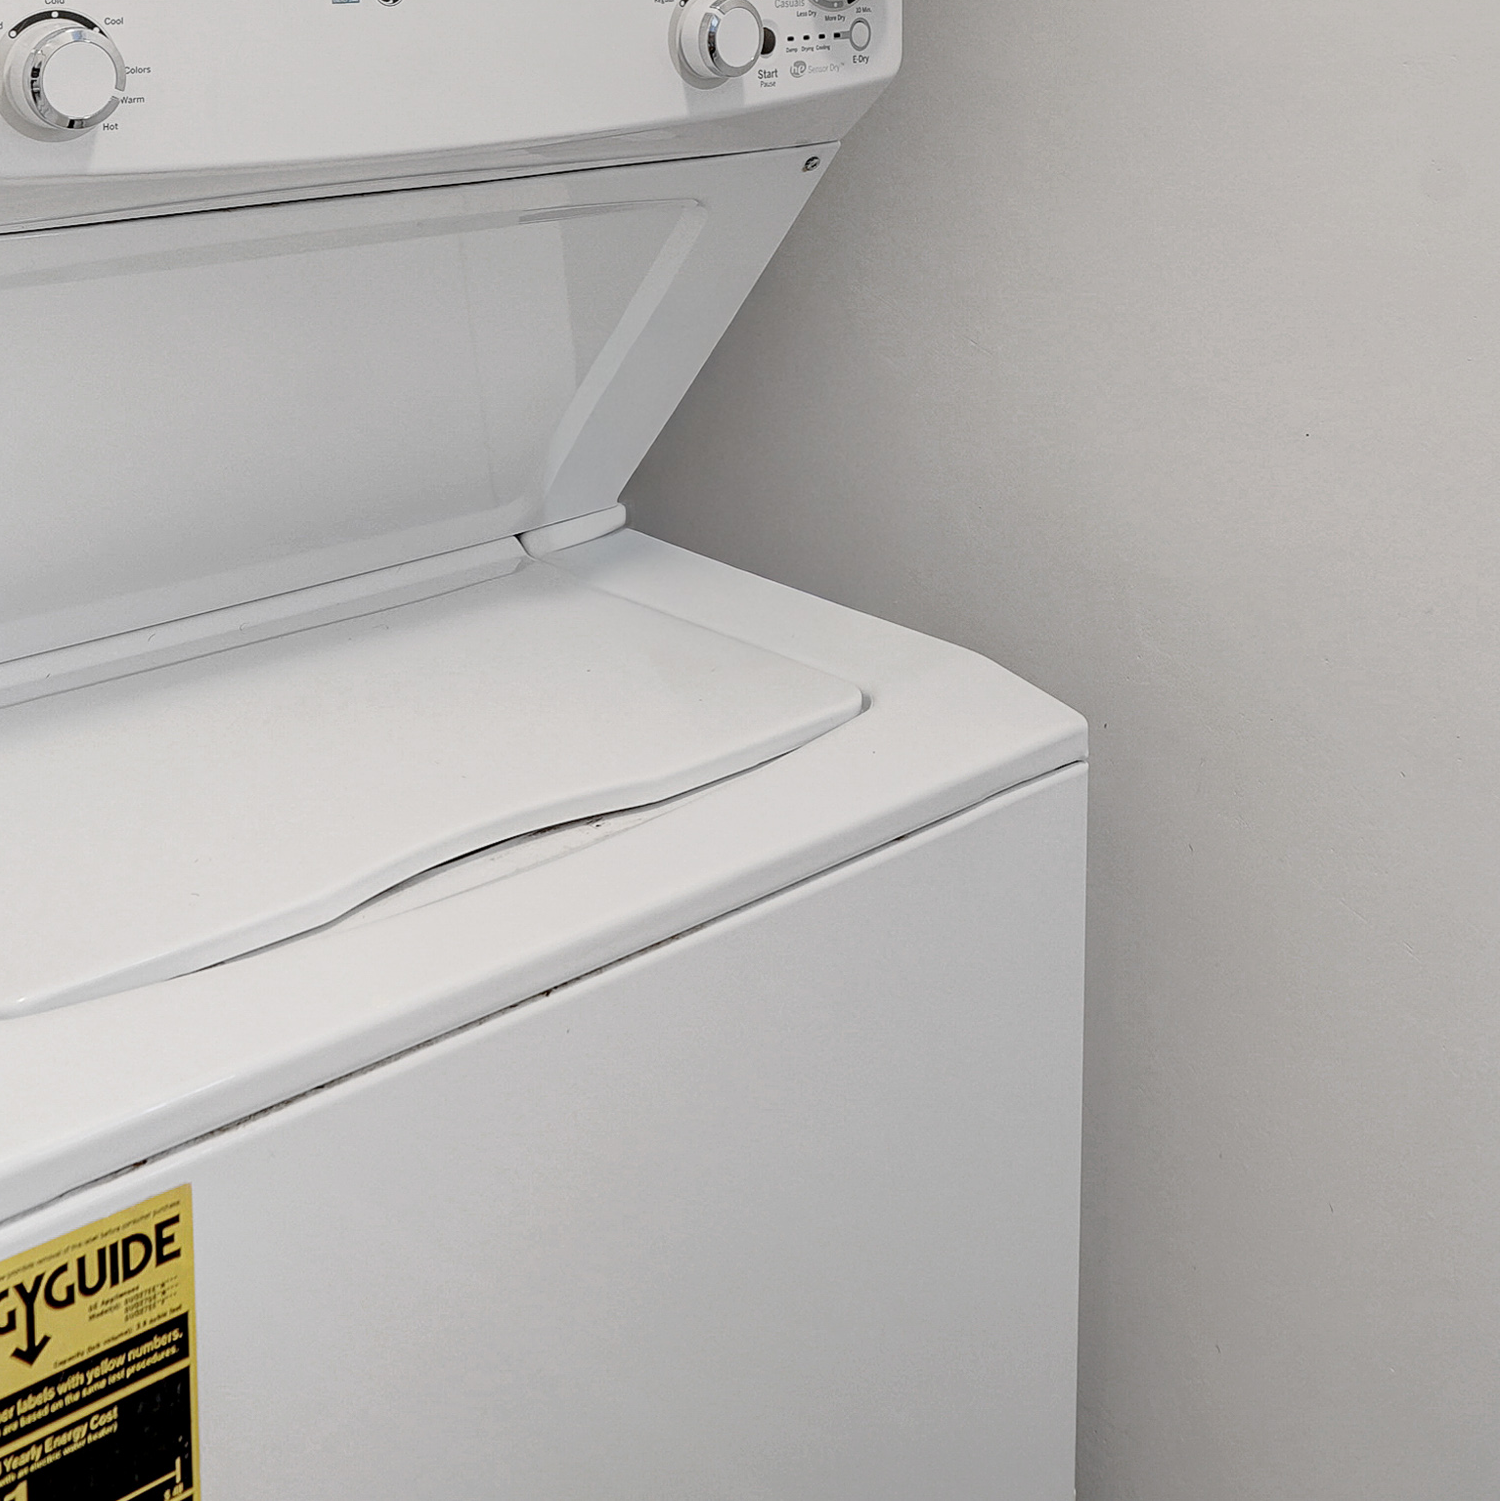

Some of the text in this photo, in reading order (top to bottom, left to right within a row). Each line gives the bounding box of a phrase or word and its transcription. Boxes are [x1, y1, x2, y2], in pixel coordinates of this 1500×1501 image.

[808, 10, 817, 18] Dry
[836, 14, 846, 22] Dry
[104, 17, 124, 26] Cool
[853, 55, 870, 64] E-Dry
[758, 69, 778, 79] Start
[102, 123, 119, 131] Hot
[17, 1387, 55, 1416] labels
[57, 1372, 84, 1395] with
[86, 1353, 126, 1385] yellow
[128, 1328, 183, 1361] numbers.
[3, 1445, 42, 1472] Yearly
[45, 1422, 88, 1453] Energy
[90, 1406, 118, 1430] Cost
